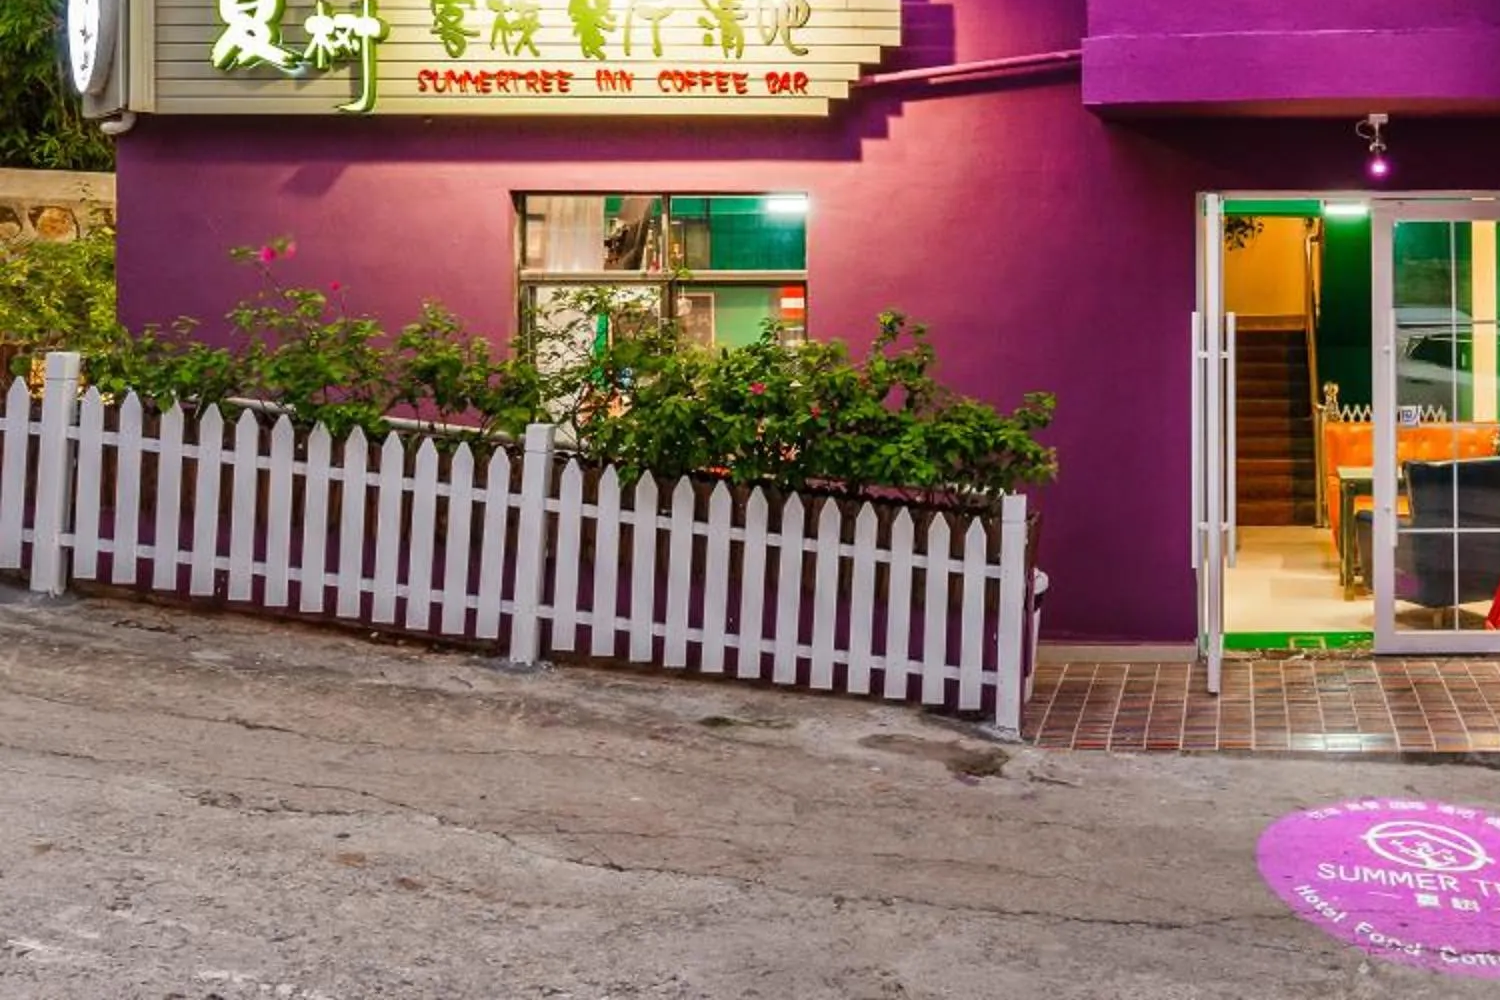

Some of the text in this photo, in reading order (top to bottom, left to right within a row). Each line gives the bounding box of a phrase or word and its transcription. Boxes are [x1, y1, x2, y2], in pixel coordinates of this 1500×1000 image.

[417, 69, 809, 95] SUMMERTREE INN COFFEE BAR
[1316, 862, 1460, 893] SUMMER
[1293, 884, 1348, 923] Hotel
